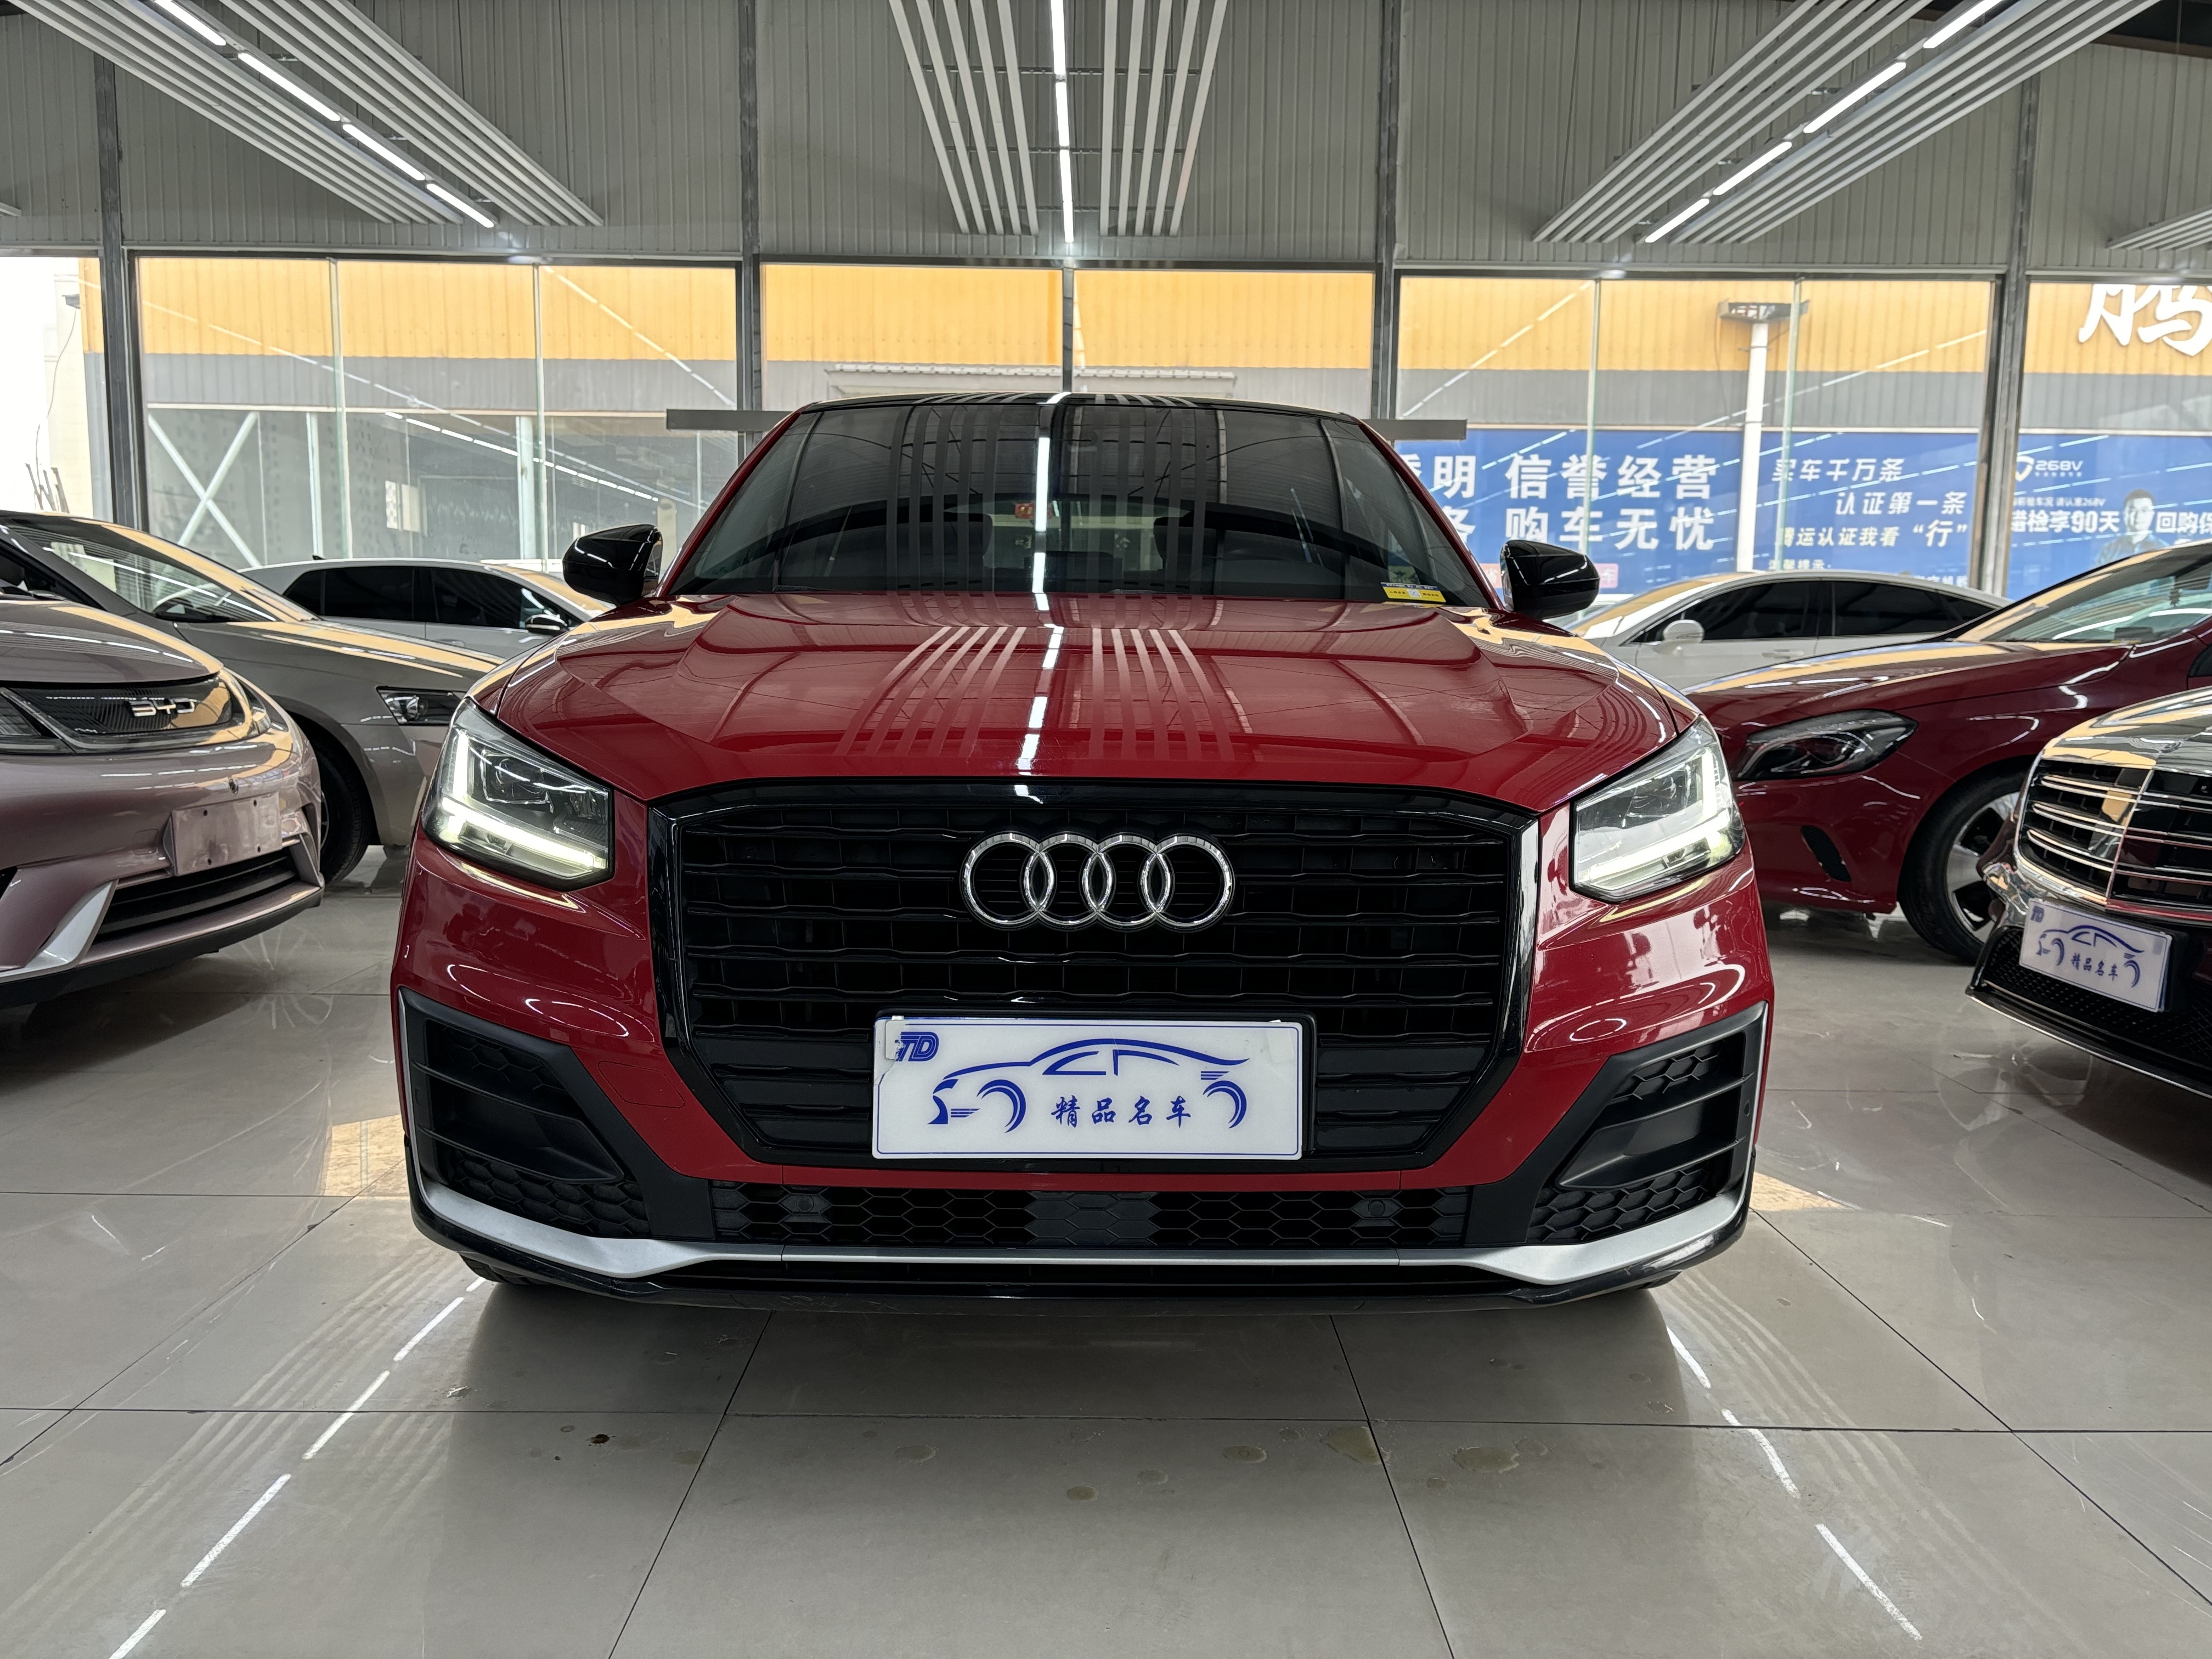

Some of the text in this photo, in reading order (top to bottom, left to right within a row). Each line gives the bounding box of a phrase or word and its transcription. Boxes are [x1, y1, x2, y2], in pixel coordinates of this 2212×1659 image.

[1505, 454, 1717, 499] 信誉经营
[1772, 458, 1905, 482] 买车千万条
[2035, 460, 2084, 471] 268V
[1836, 491, 1967, 515] 认证第一条
[1505, 506, 1714, 550] 购车无忧
[2070, 952, 2119, 981] 精品名车
[895, 1031, 939, 1062] TD
[1051, 1095, 1192, 1128] 精品名车
